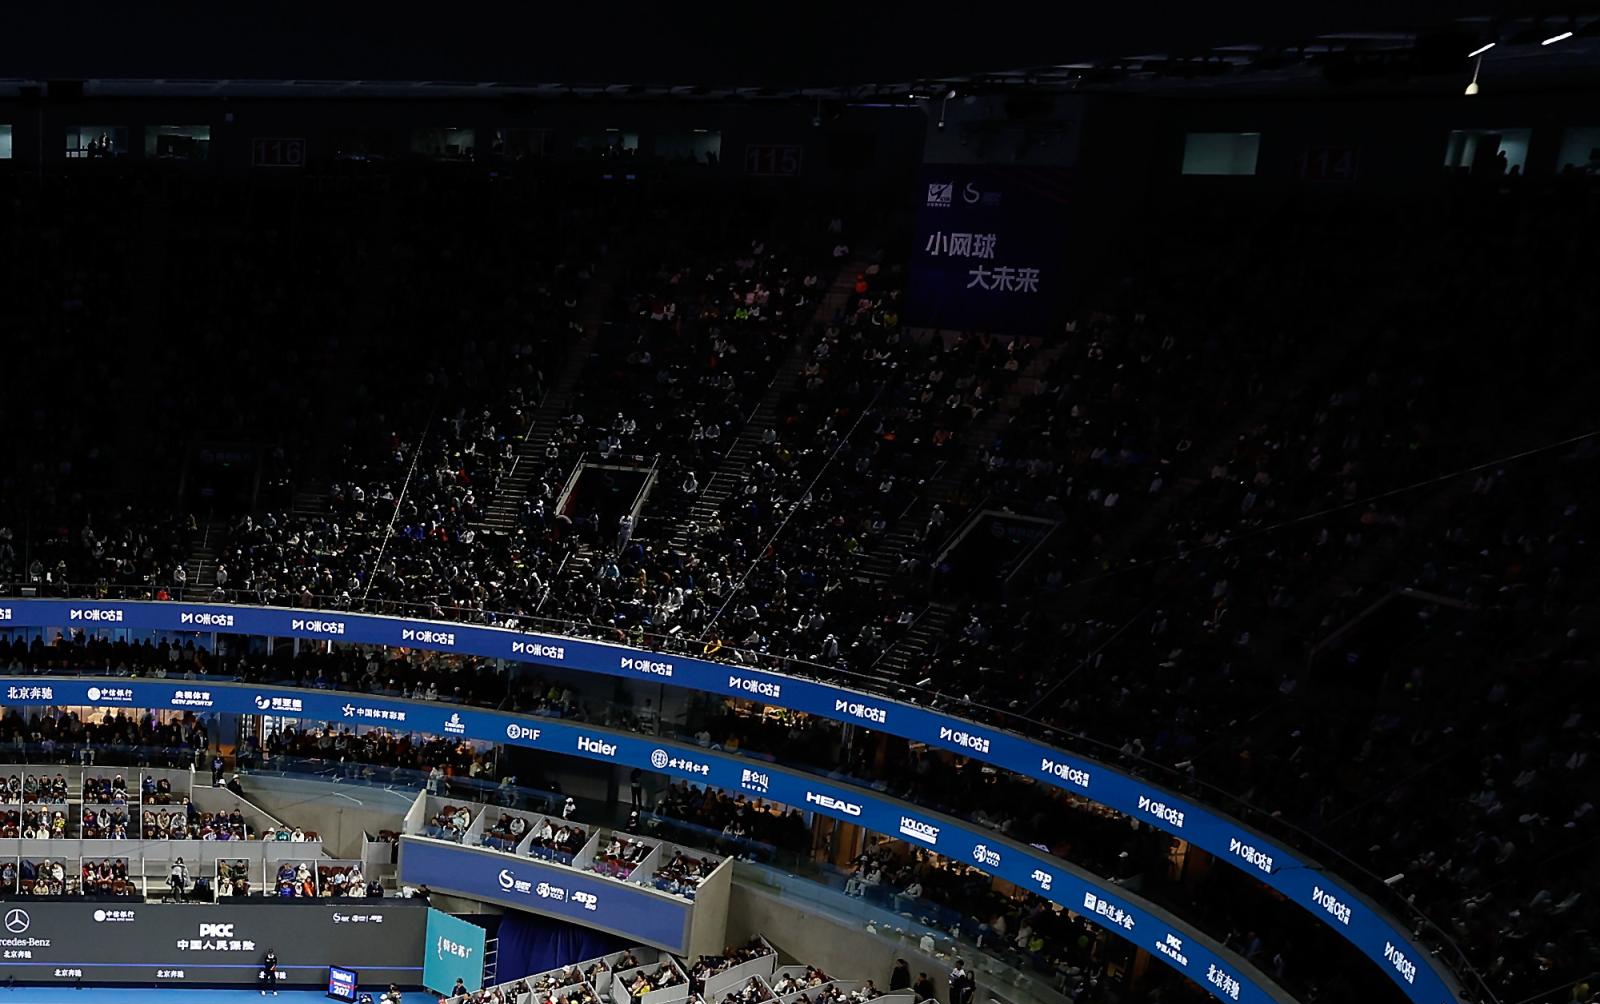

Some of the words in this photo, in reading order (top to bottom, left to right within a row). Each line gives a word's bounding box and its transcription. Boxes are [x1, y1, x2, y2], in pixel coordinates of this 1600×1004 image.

[925, 231, 998, 259] 小网球
[967, 265, 1040, 293] 大未来
[8, 687, 52, 699] 北京奔驰
[522, 728, 540, 740] PIF
[578, 737, 616, 756] Haier
[742, 769, 769, 789] 昆仑山
[807, 792, 862, 815] HEAD
[901, 816, 939, 837] HOLOGIC
[200, 924, 233, 937] PICC
[4, 950, 31, 958] 北京奔驰
[177, 940, 255, 950] 中国人民保险
[334, 985, 349, 997] 207
[1207, 964, 1239, 1000] 北京奔驰
